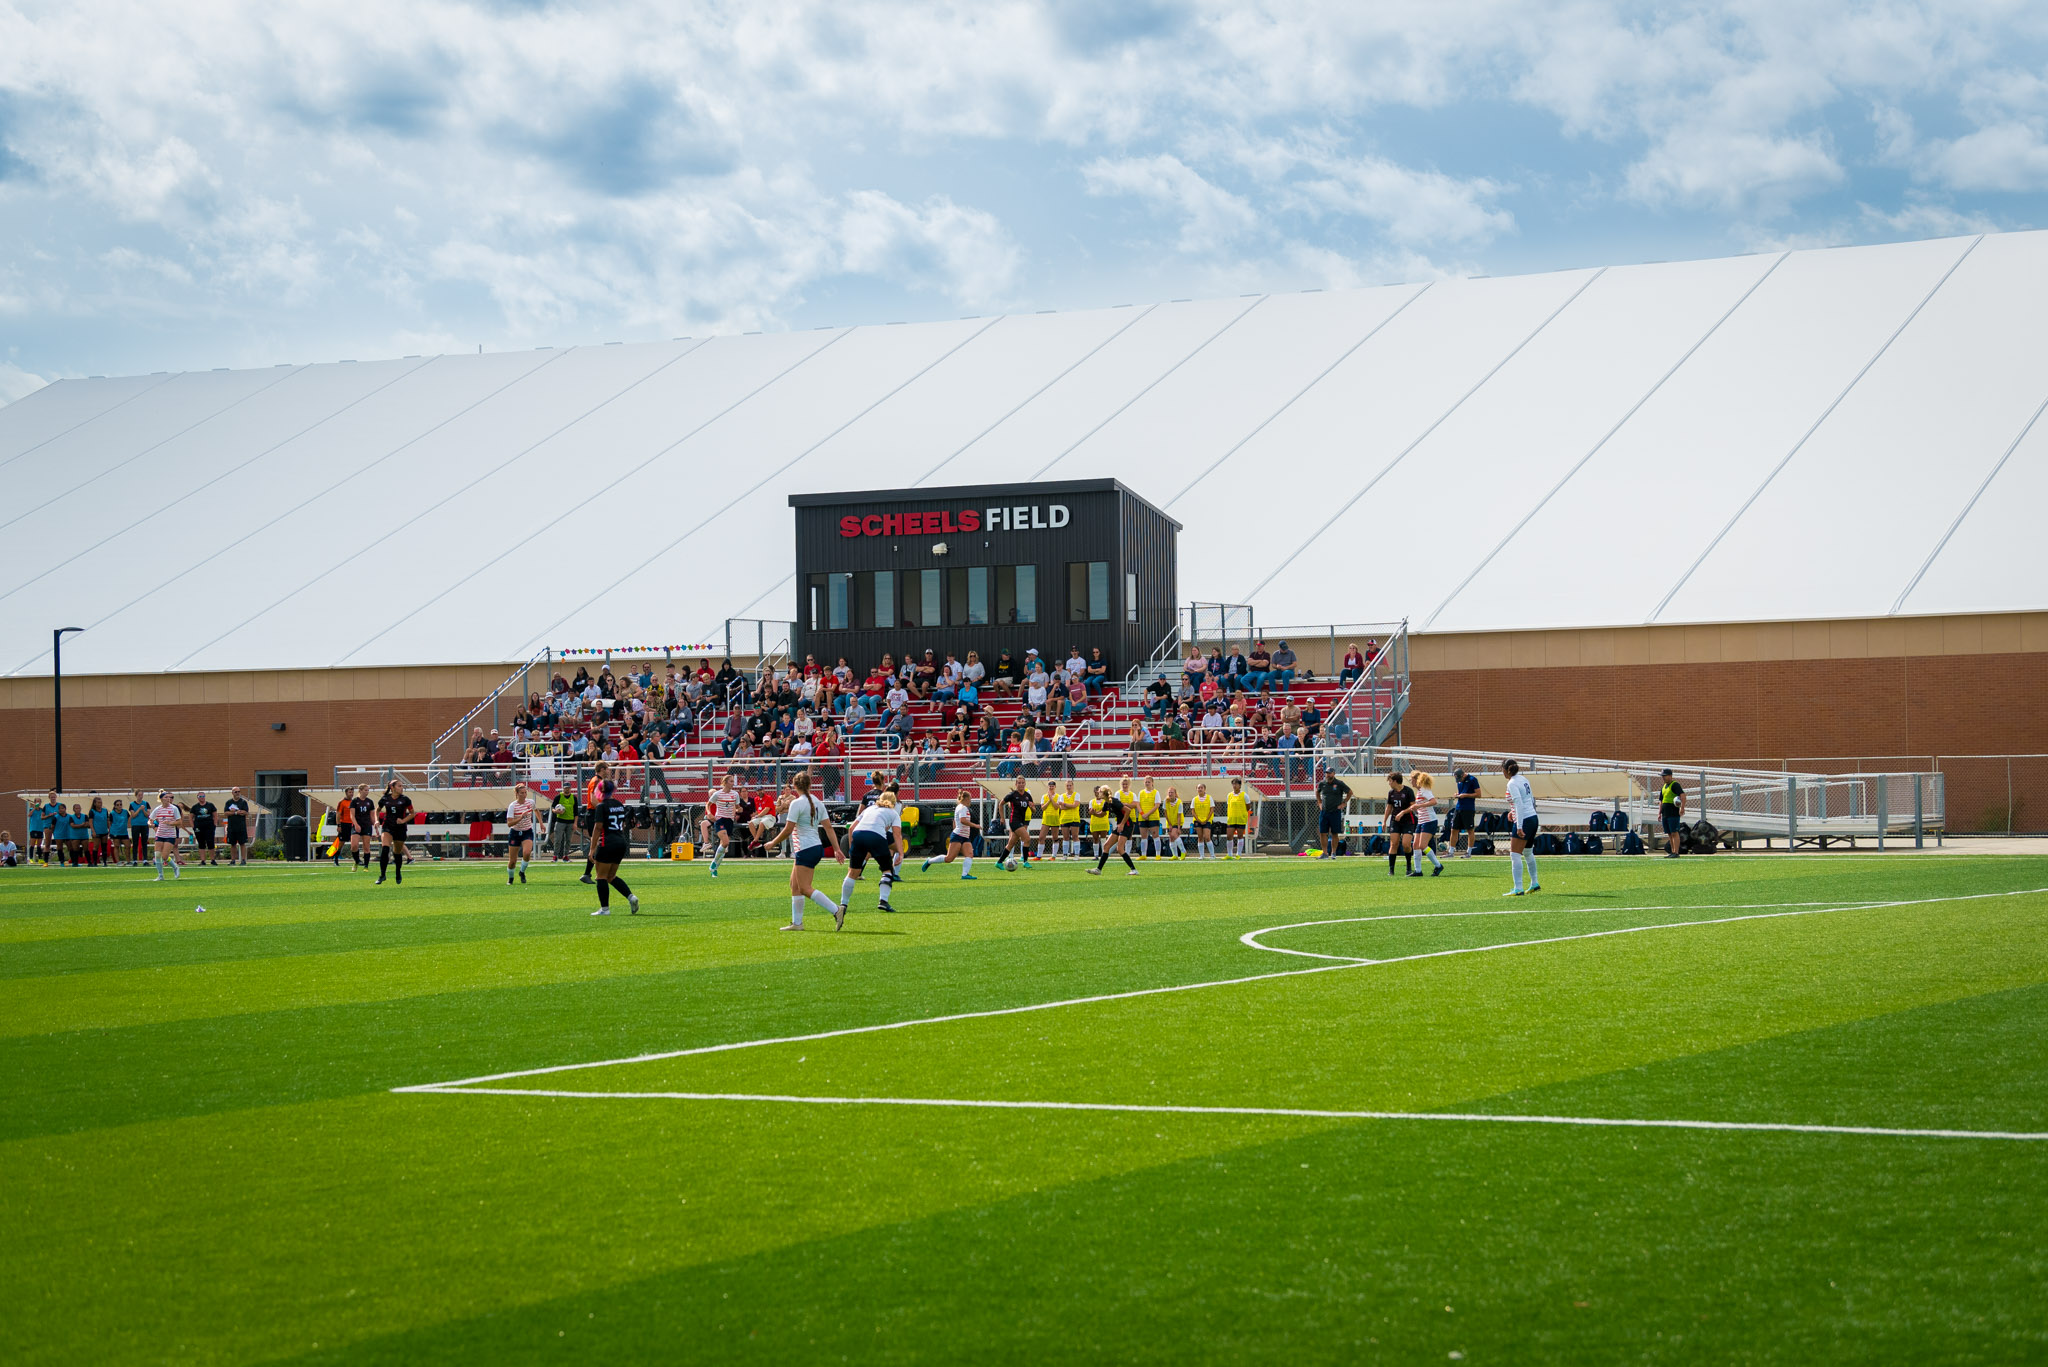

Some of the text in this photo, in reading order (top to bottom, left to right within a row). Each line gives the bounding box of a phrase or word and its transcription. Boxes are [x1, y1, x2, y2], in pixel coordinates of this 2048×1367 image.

[839, 505, 1070, 538] SCHEELS FIELD
[1394, 800, 1402, 808] 21
